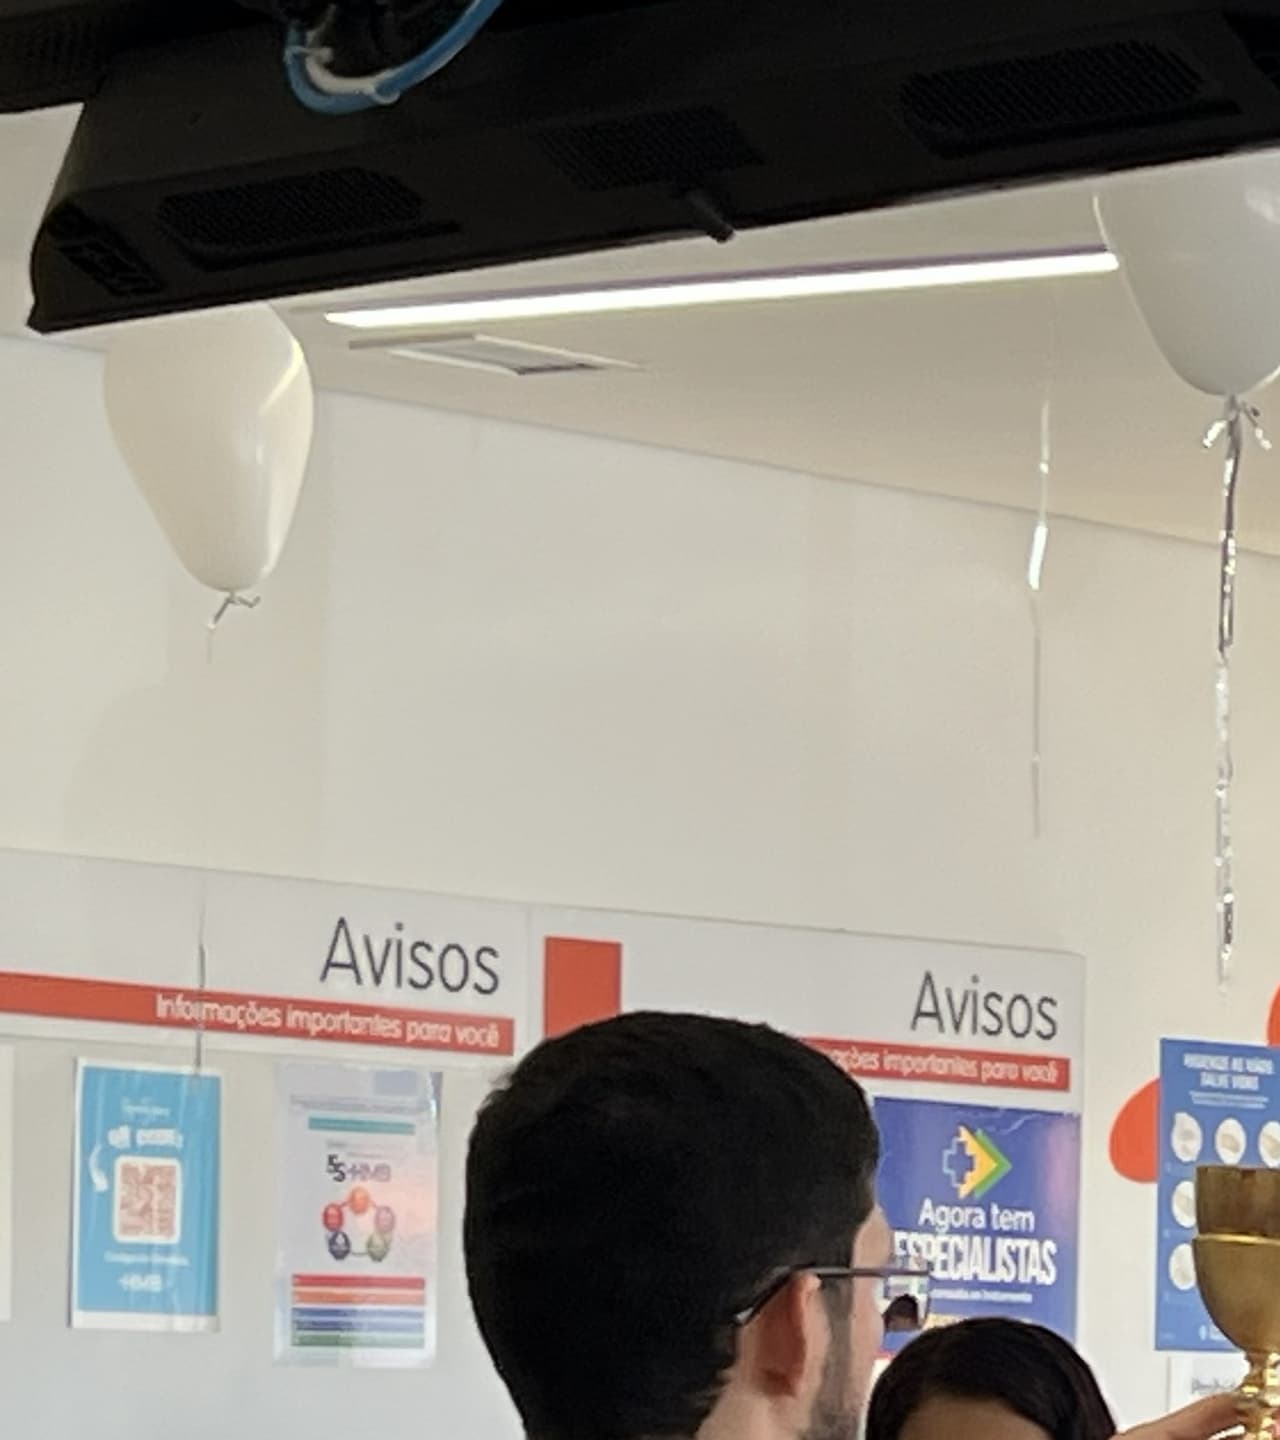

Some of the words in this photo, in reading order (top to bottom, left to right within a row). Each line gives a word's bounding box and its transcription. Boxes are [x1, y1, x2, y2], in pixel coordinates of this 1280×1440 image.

[319, 916, 499, 995] Avisos
[286, 1004, 402, 1040] importantes
[405, 1017, 452, 1044] para
[455, 1021, 500, 1048] você
[910, 970, 1058, 1040] Avisos
[883, 1050, 978, 1081] importantes
[981, 1059, 1019, 1083] para
[918, 1198, 986, 1233] Agora
[990, 1203, 1035, 1232] tem
[893, 1230, 1057, 1285] ESPECIALISTAS
